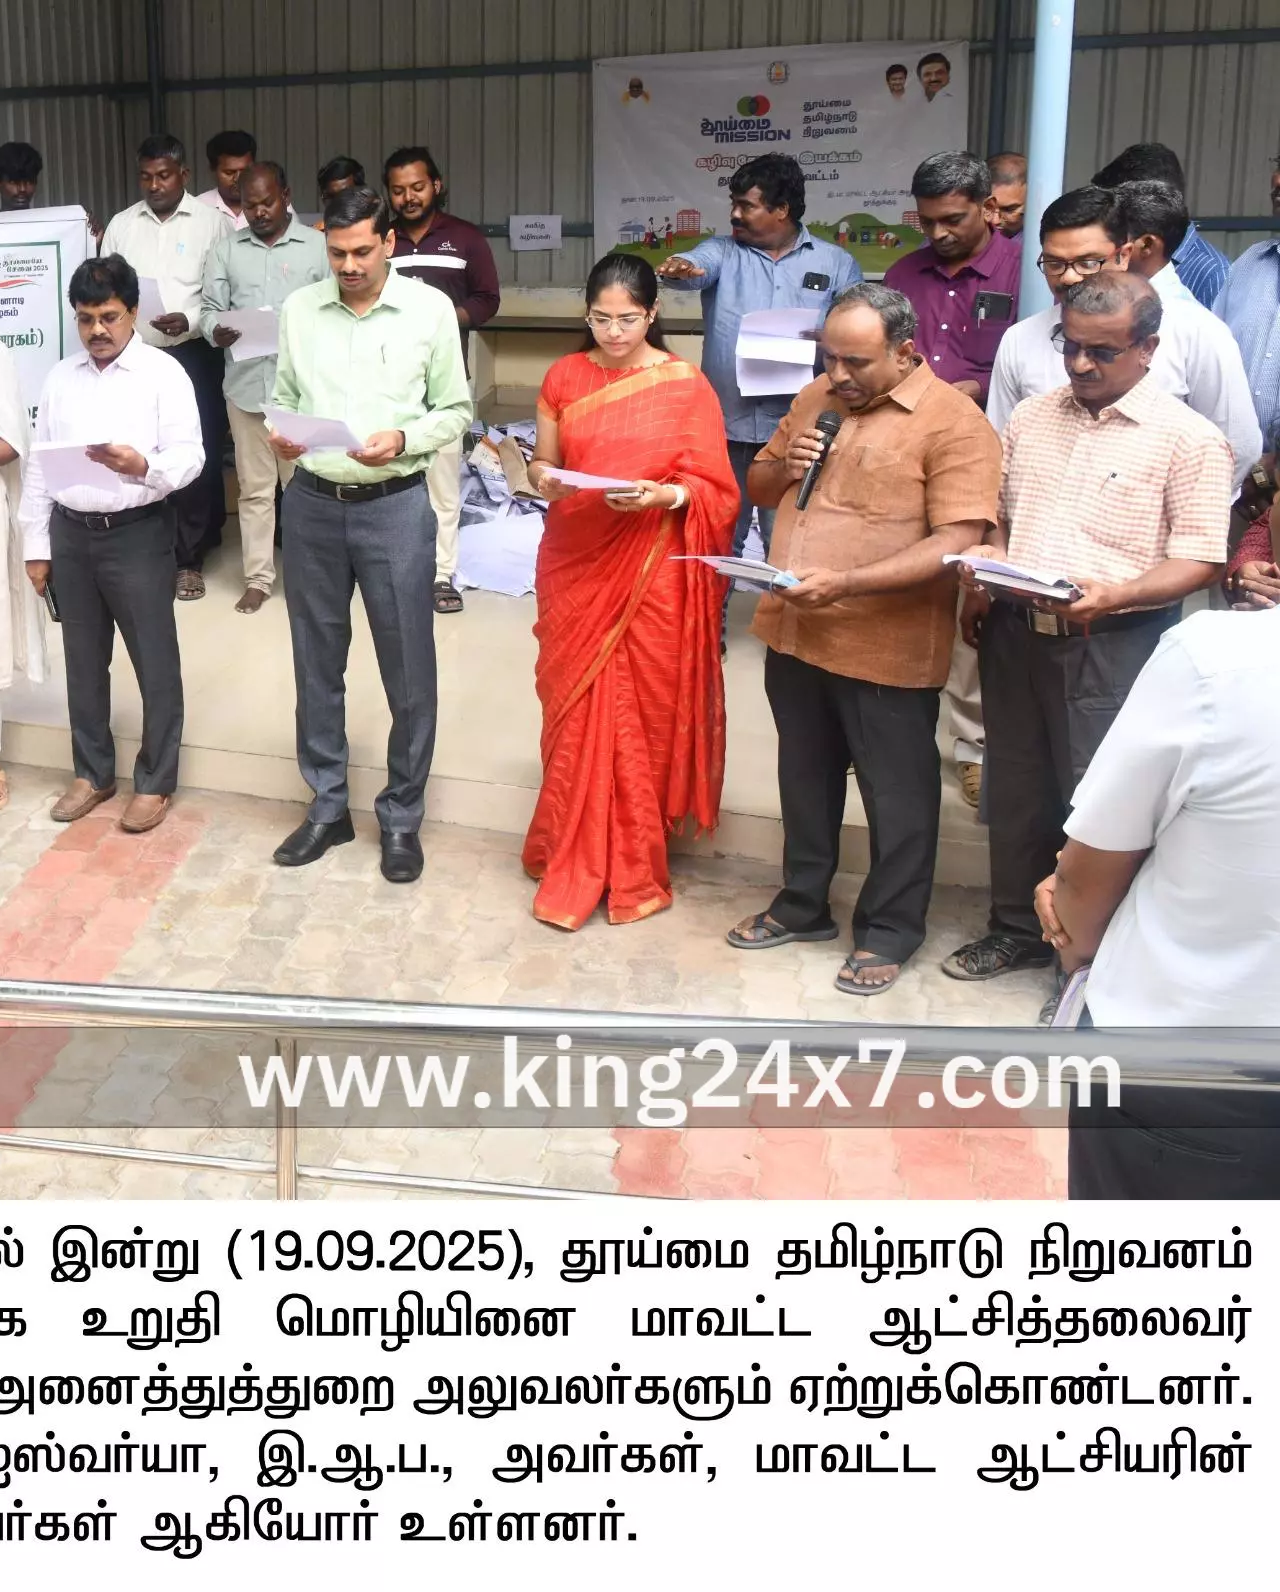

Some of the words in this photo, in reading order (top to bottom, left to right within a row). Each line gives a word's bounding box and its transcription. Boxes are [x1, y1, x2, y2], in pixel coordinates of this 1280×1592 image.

[802, 97, 852, 112] தூய்மை
[701, 115, 771, 136] தூய்மை
[802, 111, 858, 125] தமிழ்நாடு
[802, 125, 858, 139] நிறுவனம்
[696, 152, 736, 171] கழிவு
